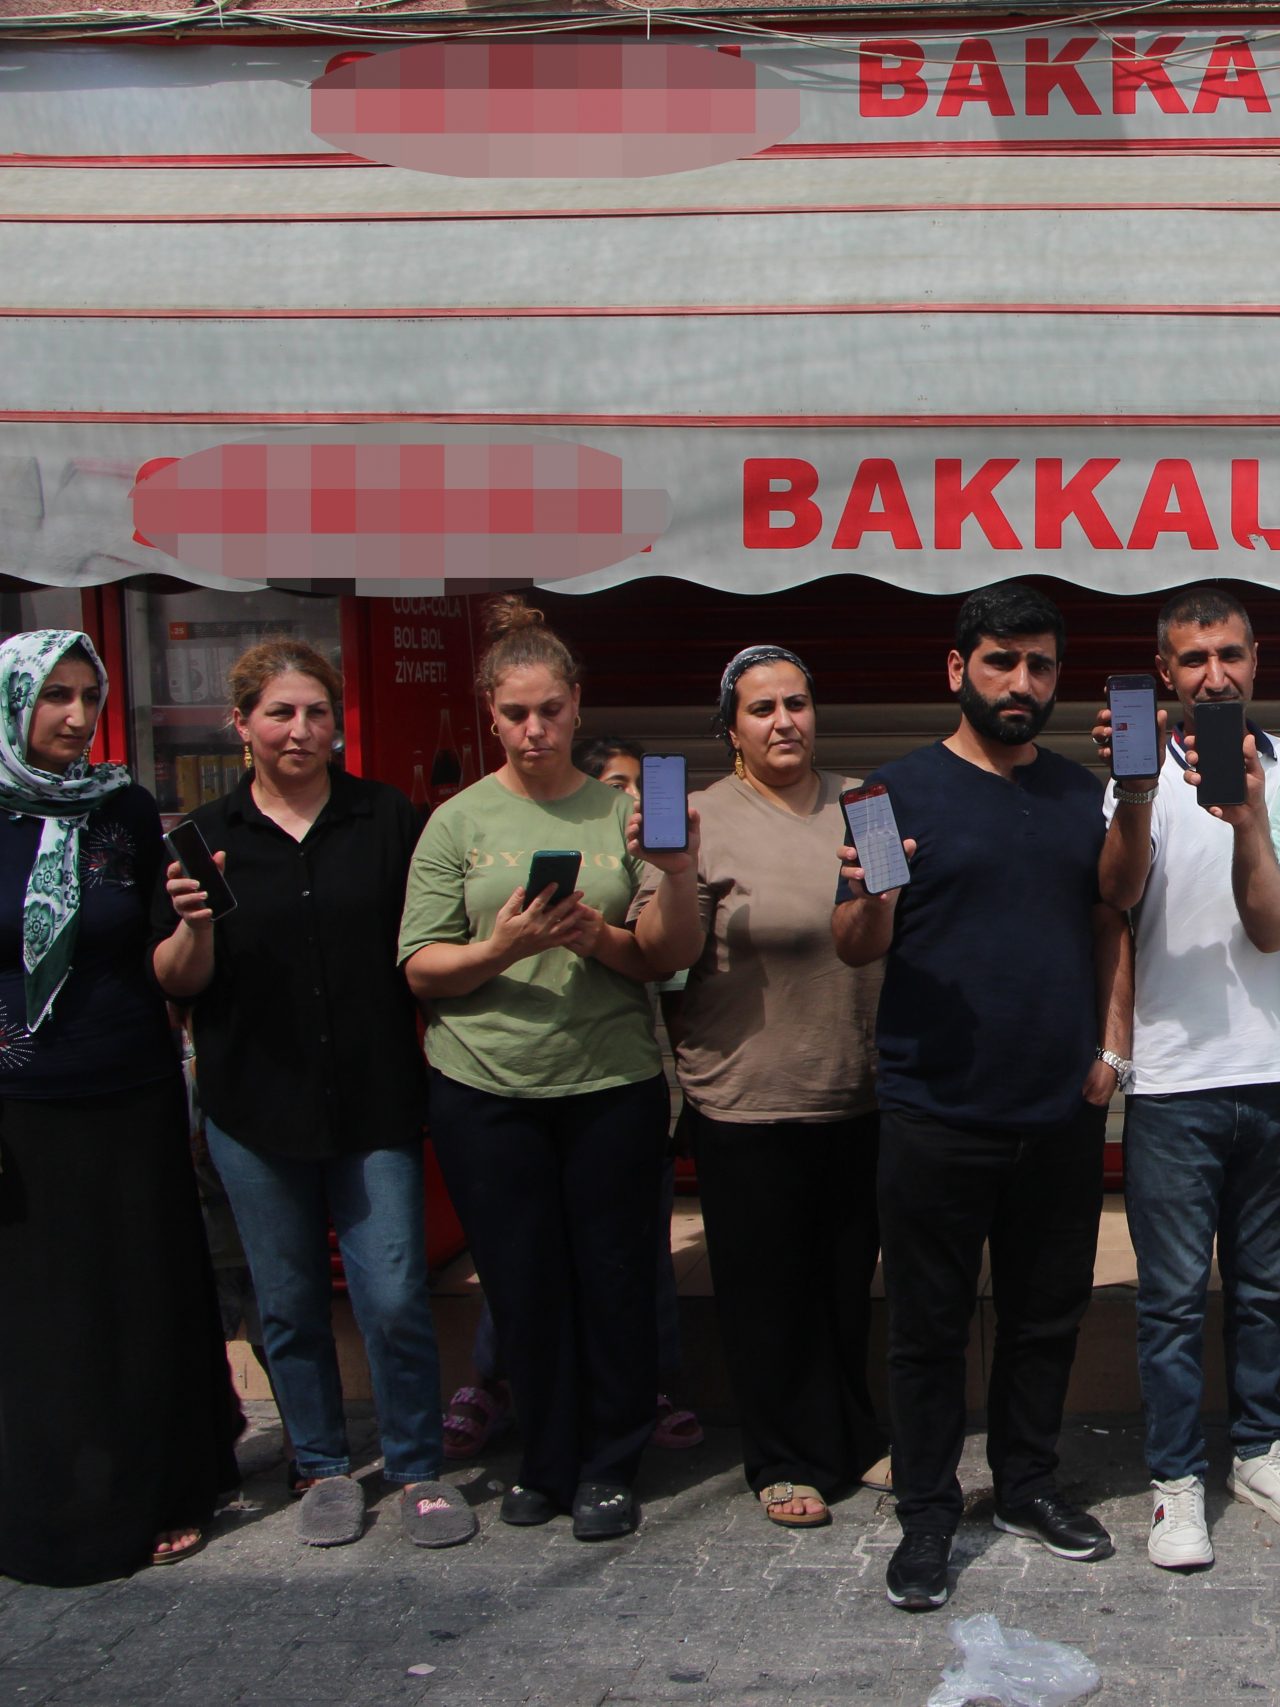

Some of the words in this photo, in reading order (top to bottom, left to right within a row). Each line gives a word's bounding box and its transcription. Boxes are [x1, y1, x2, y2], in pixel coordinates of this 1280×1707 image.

[393, 595, 463, 617] COCA-COLA
[394, 626, 419, 648] BOL
[421, 627, 445, 649] BOL
